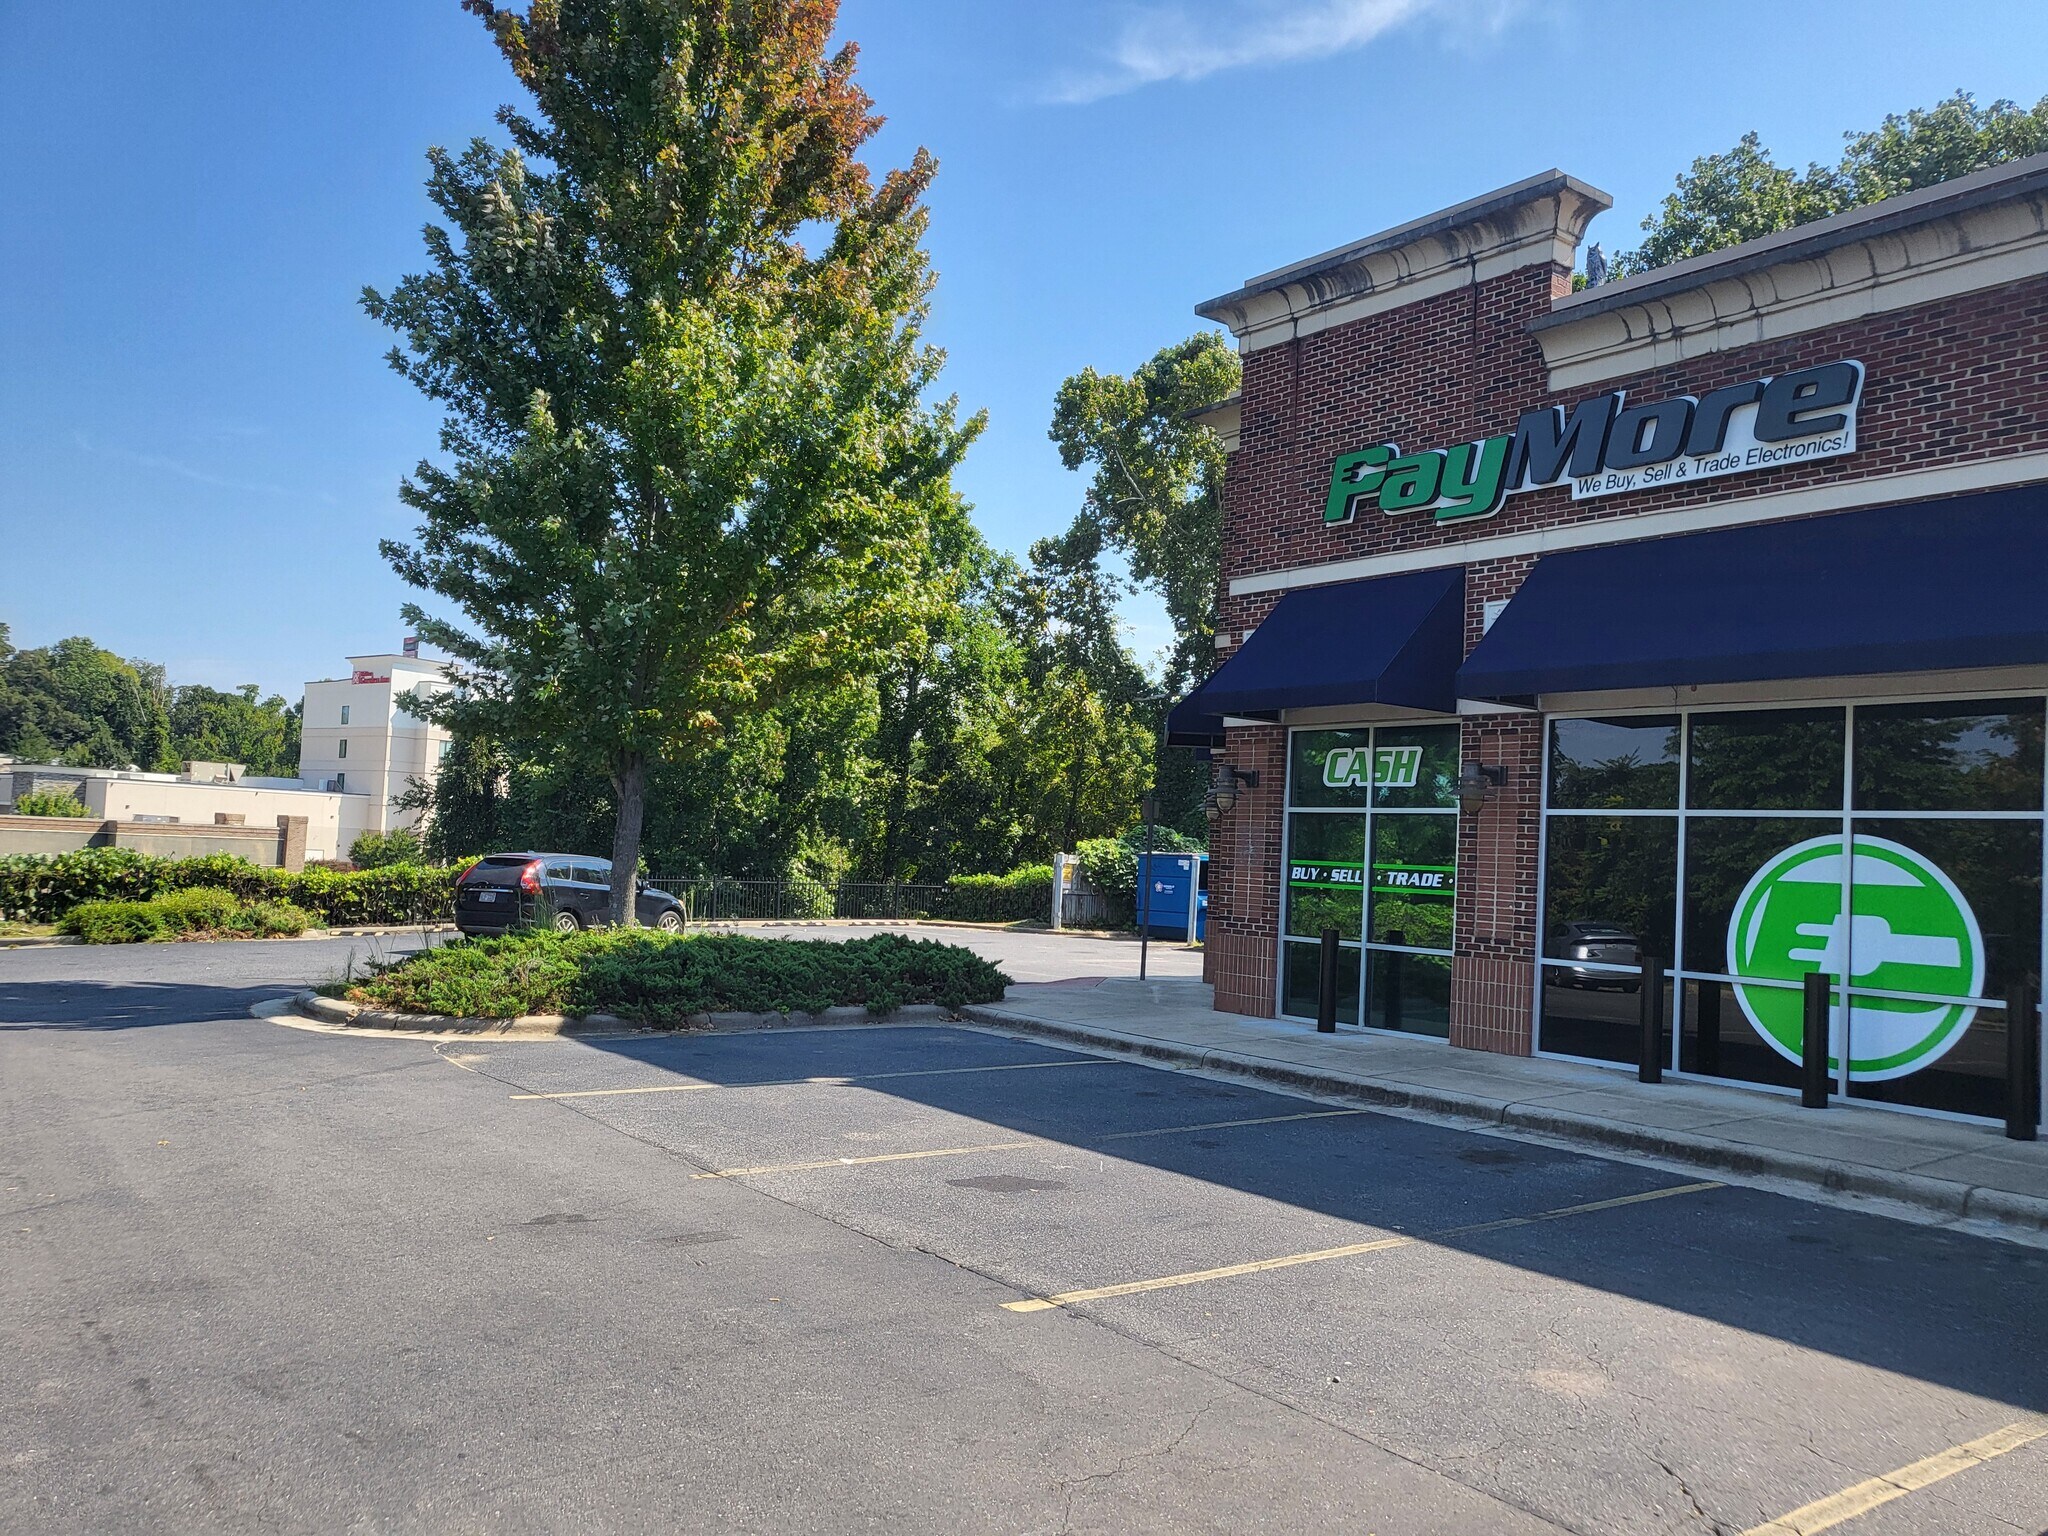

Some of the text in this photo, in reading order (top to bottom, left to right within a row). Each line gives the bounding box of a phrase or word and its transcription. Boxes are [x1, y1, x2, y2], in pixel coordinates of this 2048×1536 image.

[1323, 361, 1863, 525] PayMore
[1578, 431, 1849, 495] We Buy, Sell & Trade Electronics!
[1325, 749, 1420, 784] CASH
[1291, 866, 1444, 887] BUY SELL TRADE
